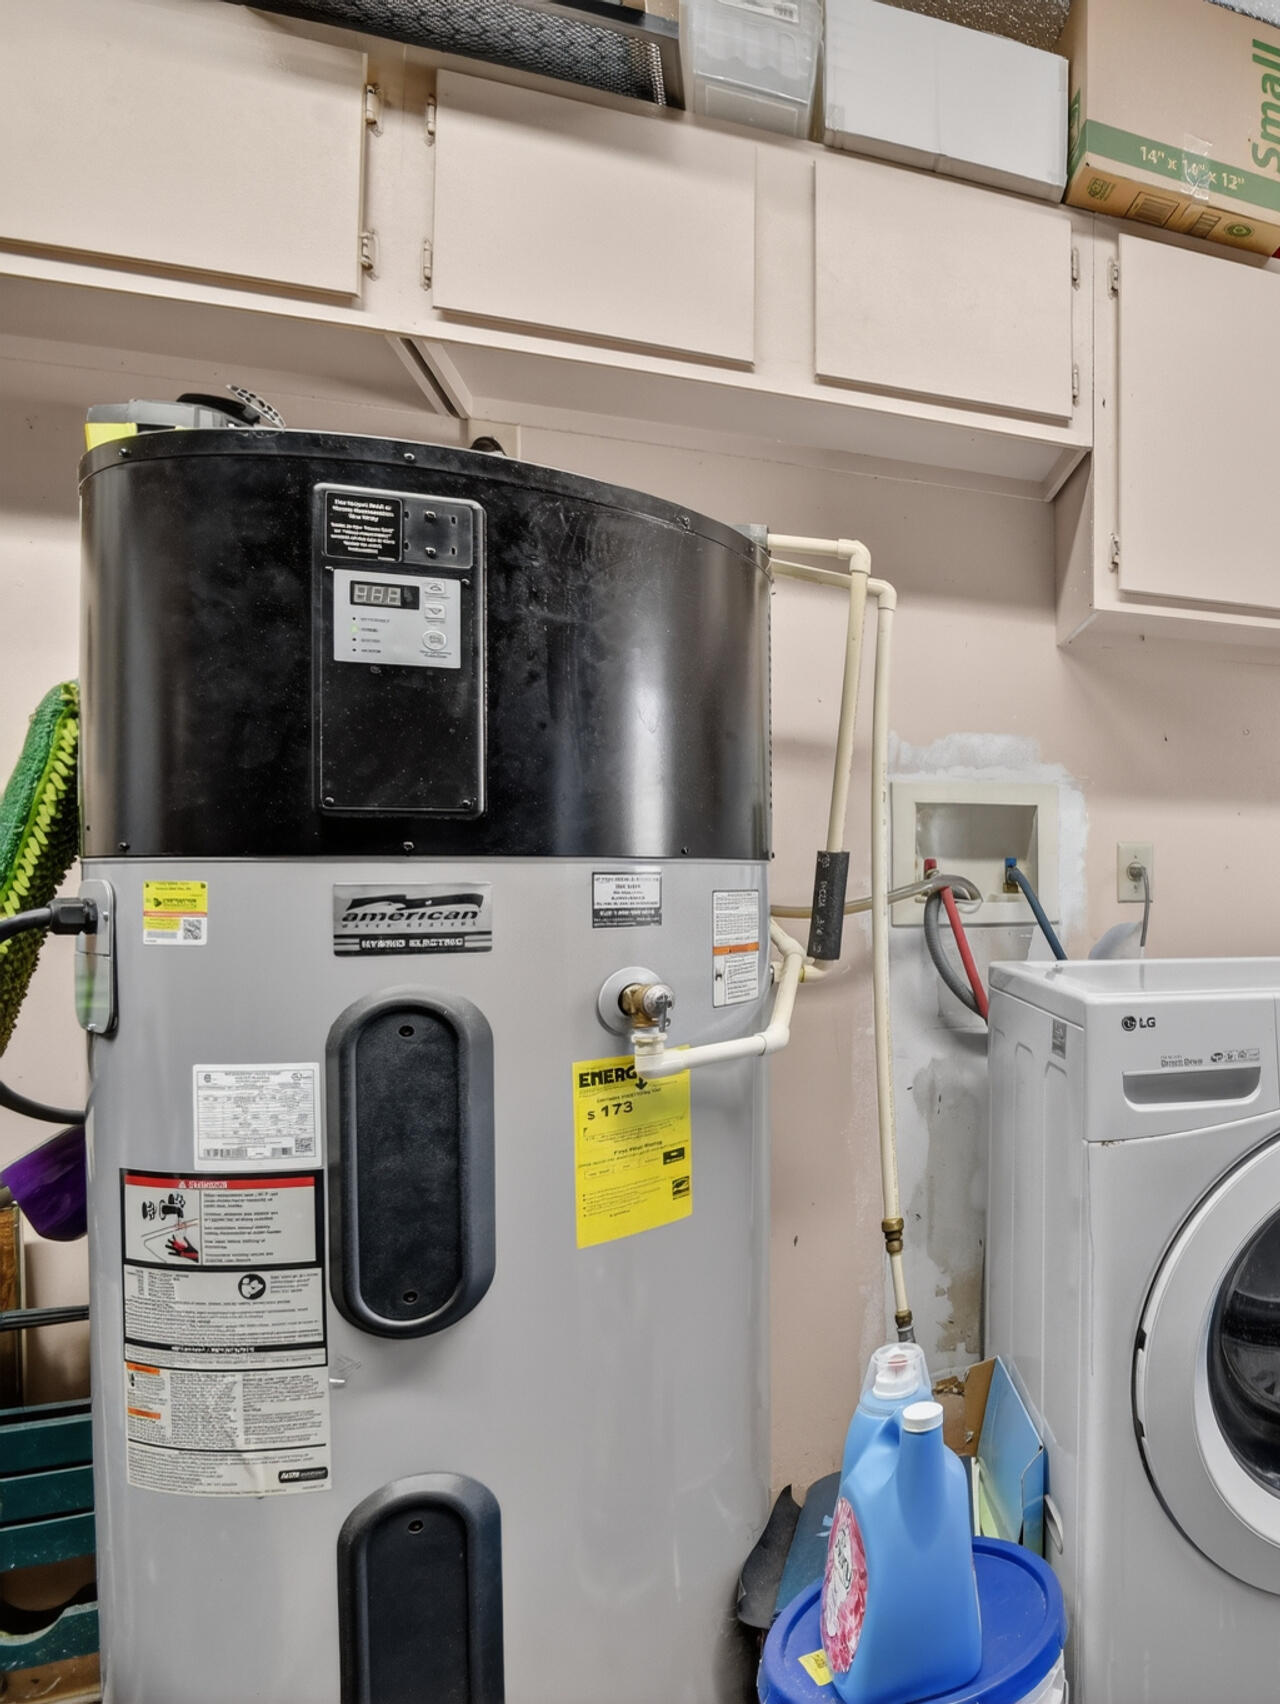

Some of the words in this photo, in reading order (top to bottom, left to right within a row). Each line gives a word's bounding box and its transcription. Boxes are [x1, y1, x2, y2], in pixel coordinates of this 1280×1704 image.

[1140, 146, 1165, 164] 14"
[1221, 172, 1245, 190] 12"
[341, 910, 478, 922] american
[361, 939, 406, 949] HYBRID
[408, 937, 464, 948] ELECTRIC
[579, 1064, 638, 1088] ENERG
[601, 1101, 633, 1117] 173
